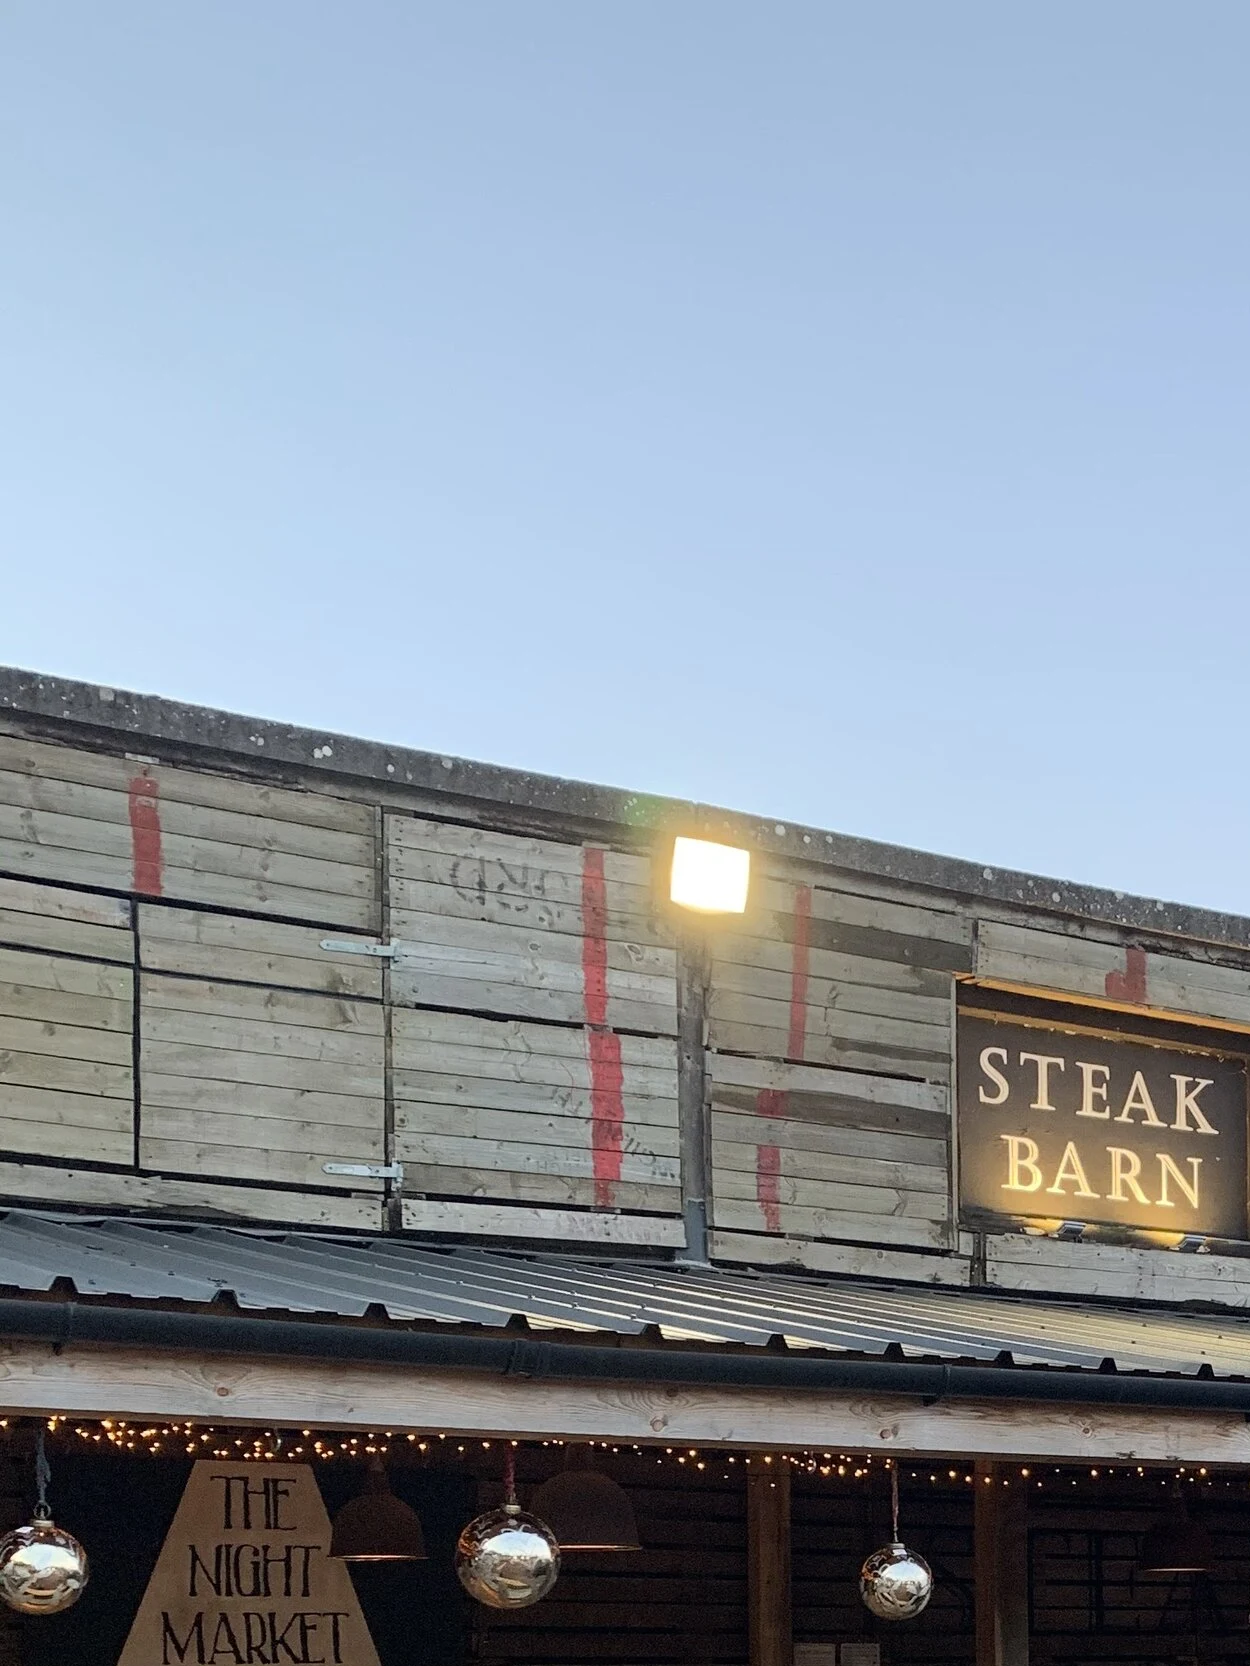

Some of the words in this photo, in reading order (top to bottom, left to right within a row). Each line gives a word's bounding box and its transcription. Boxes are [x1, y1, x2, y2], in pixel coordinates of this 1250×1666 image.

[978, 1046, 1220, 1136] STEAK
[1000, 1134, 1204, 1209] BARN
[210, 1475, 297, 1531] THE
[188, 1544, 322, 1598] NIGHT
[160, 1611, 350, 1665] MARKET
